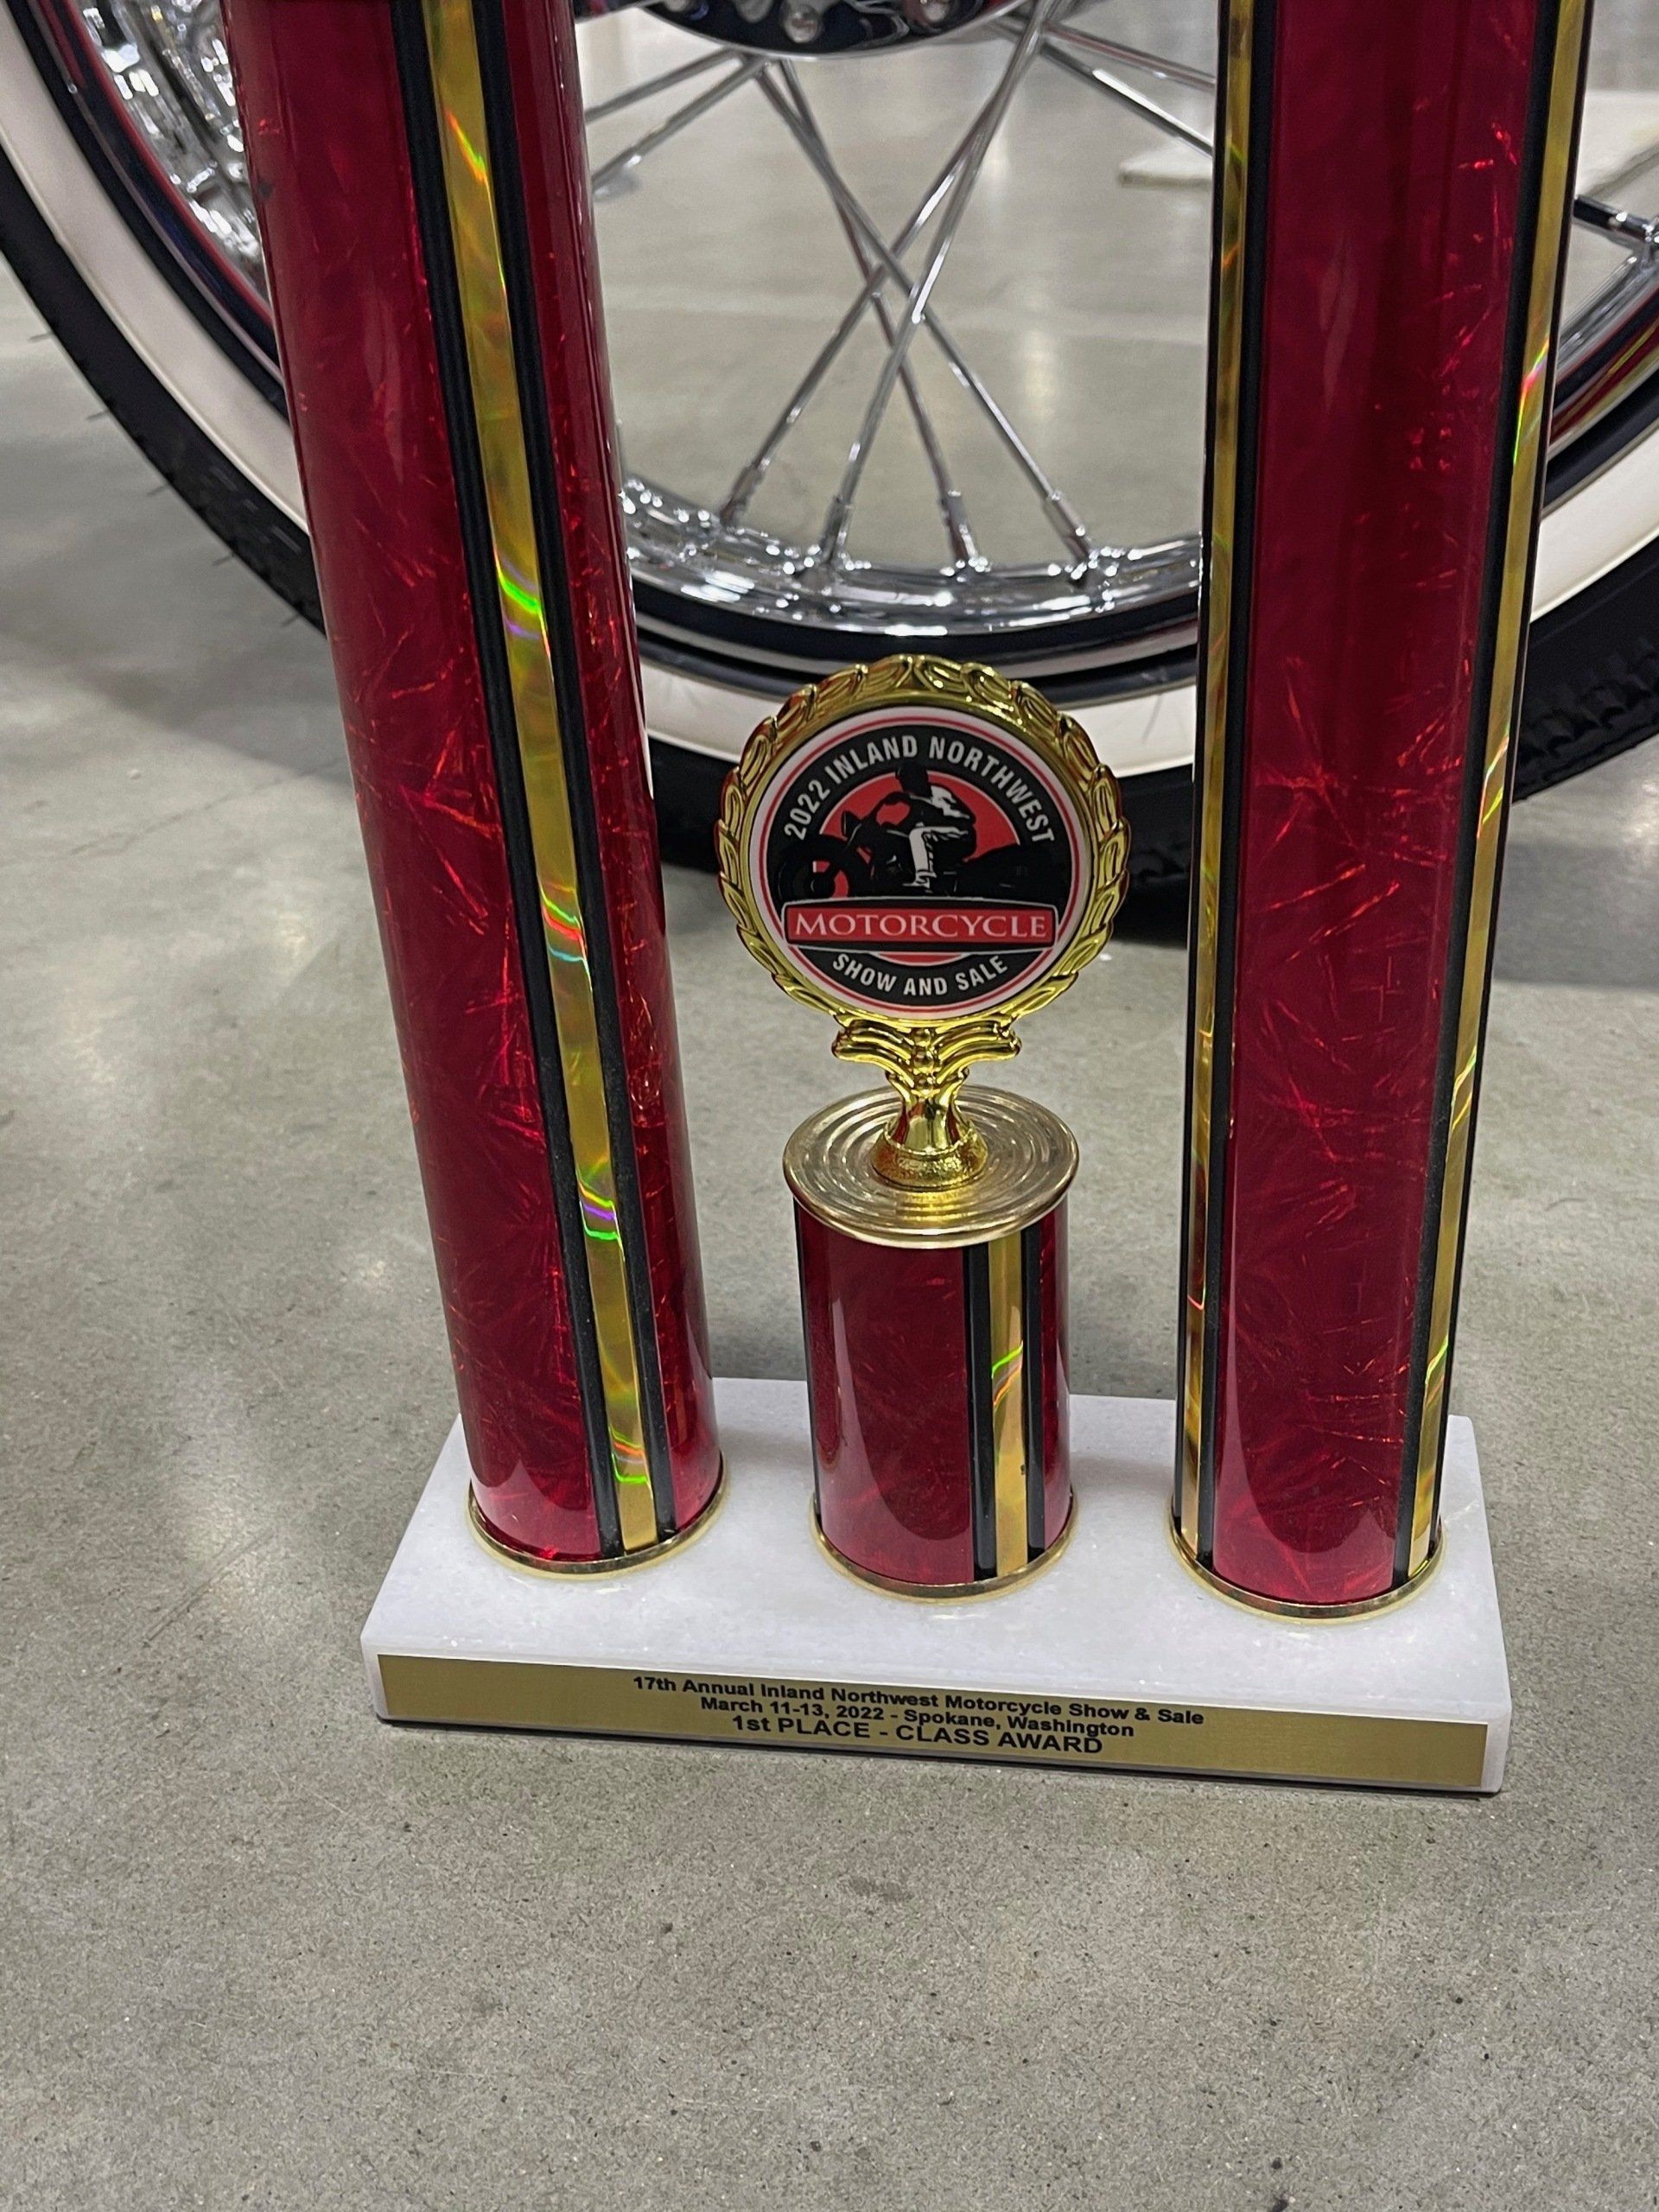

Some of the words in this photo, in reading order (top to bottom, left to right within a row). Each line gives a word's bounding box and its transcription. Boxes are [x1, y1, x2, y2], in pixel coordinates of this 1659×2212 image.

[784, 779, 831, 842] 2022
[824, 734, 918, 785] INLAND
[929, 735, 1055, 843] NORTHWEST
[795, 912, 1047, 938] MOTORCYCLE
[832, 952, 897, 993] SHOW
[903, 976, 948, 996] AND
[956, 955, 1008, 992] SALE
[633, 1676, 677, 1693] 17th
[683, 1679, 754, 1697] Annual
[761, 1683, 824, 1700] Inland
[831, 1688, 939, 1708] Northwest
[945, 1694, 1062, 1716] Motorcycle
[1069, 1703, 1129, 1720] Show
[1135, 1707, 1150, 1721] &
[1158, 1708, 1205, 1725] Sale
[701, 1696, 763, 1713] March
[770, 1701, 830, 1719] 11-13,
[836, 1705, 884, 1720] 2022
[904, 1709, 1001, 1730] Spokane,
[1007, 1715, 1135, 1738] Washington
[733, 1715, 771, 1732] 1st
[778, 1718, 870, 1738] PLACE
[896, 1725, 989, 1746] CLASS
[998, 1732, 1103, 1754] AWARD
